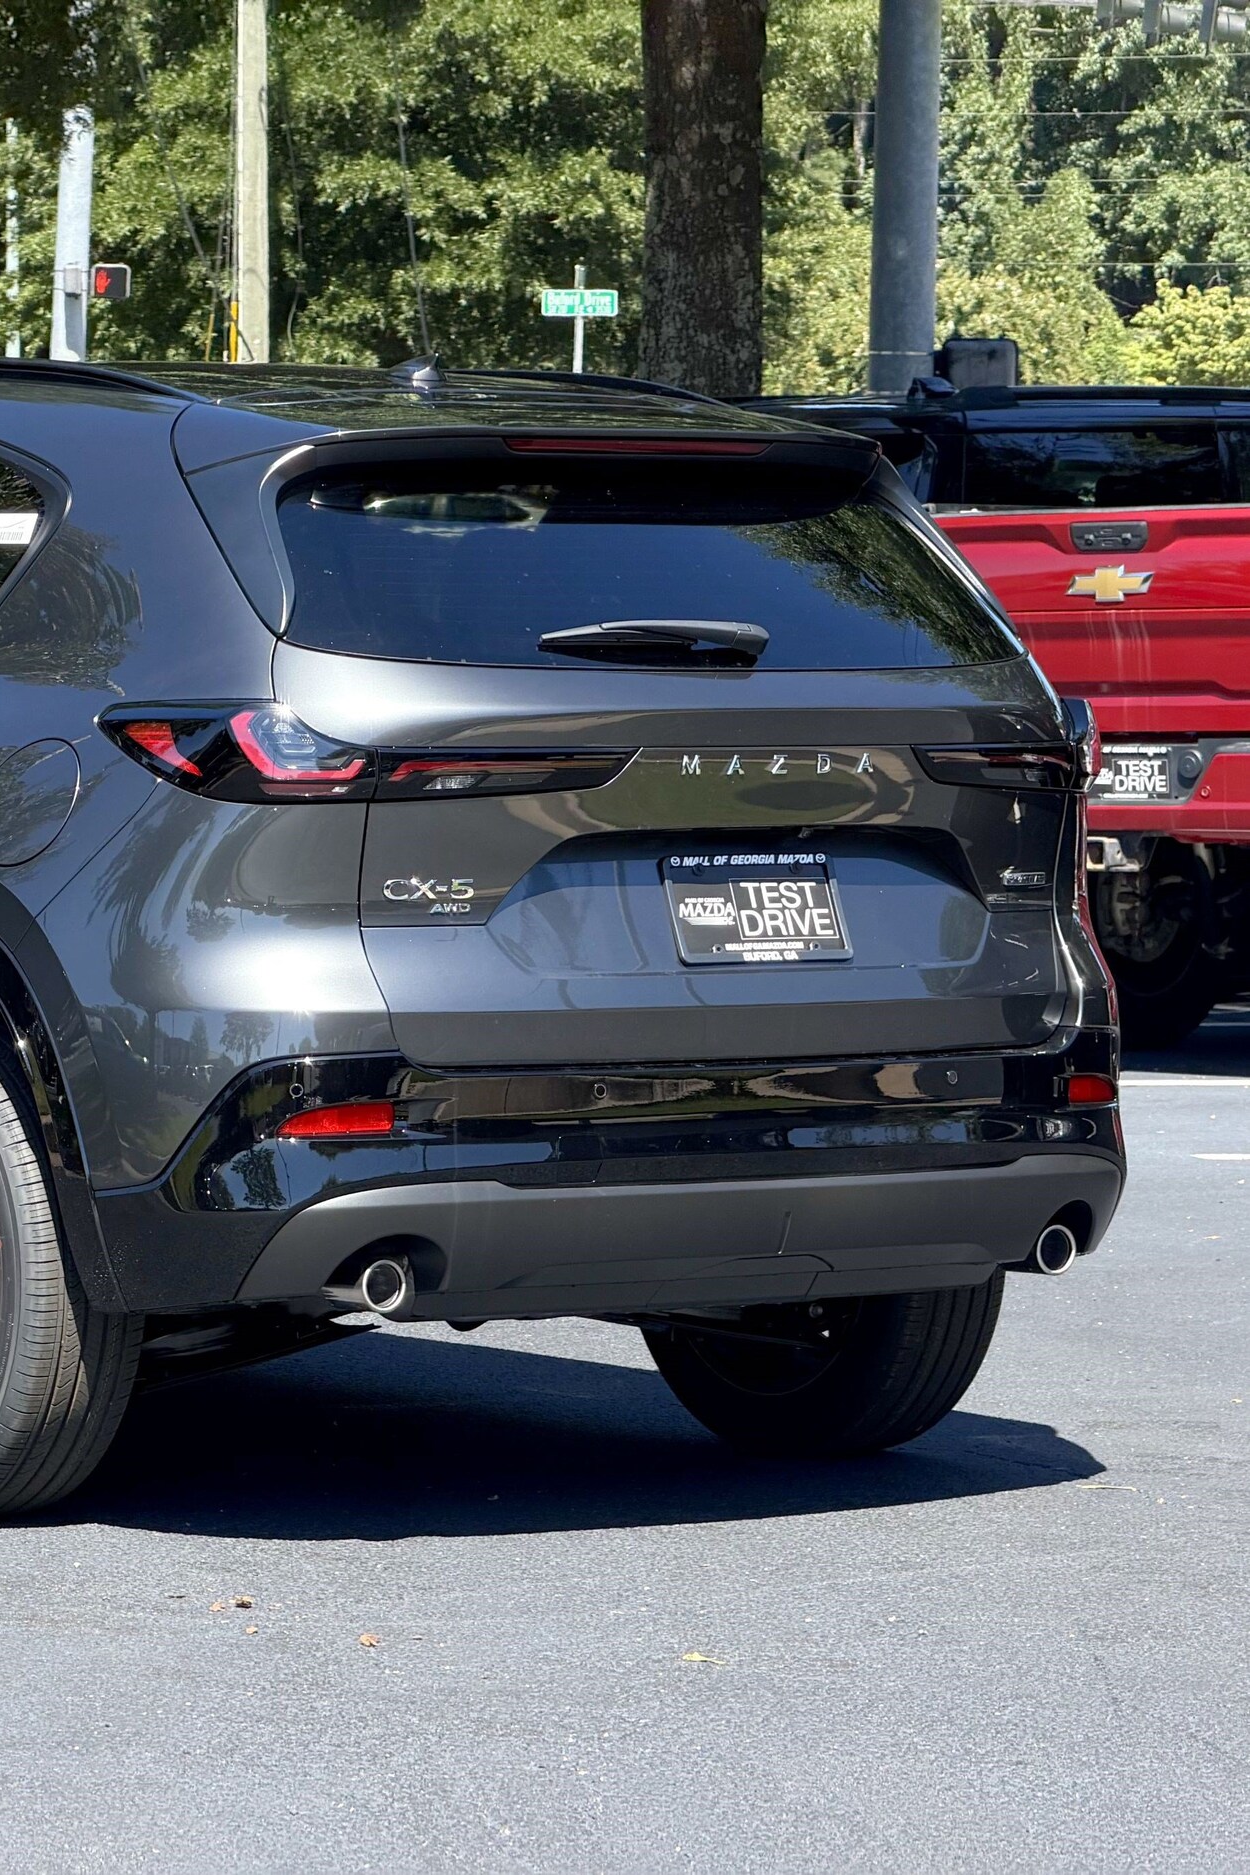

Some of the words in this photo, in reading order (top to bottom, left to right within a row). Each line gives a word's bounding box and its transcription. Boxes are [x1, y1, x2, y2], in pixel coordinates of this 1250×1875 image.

[681, 753, 874, 775] MAZDA
[1116, 760, 1162, 776] TEST
[1114, 775, 1167, 792] DRIVE
[682, 856, 710, 866] MALL
[713, 855, 728, 866] OF
[730, 854, 775, 865] GEORGIA
[777, 854, 814, 864] MAZDA
[383, 877, 475, 900] CX-5
[739, 881, 817, 909] TEST
[430, 903, 471, 914] AWD
[679, 902, 736, 918] MAZDA
[740, 908, 834, 937] DRIVE
[785, 950, 799, 960] GA
